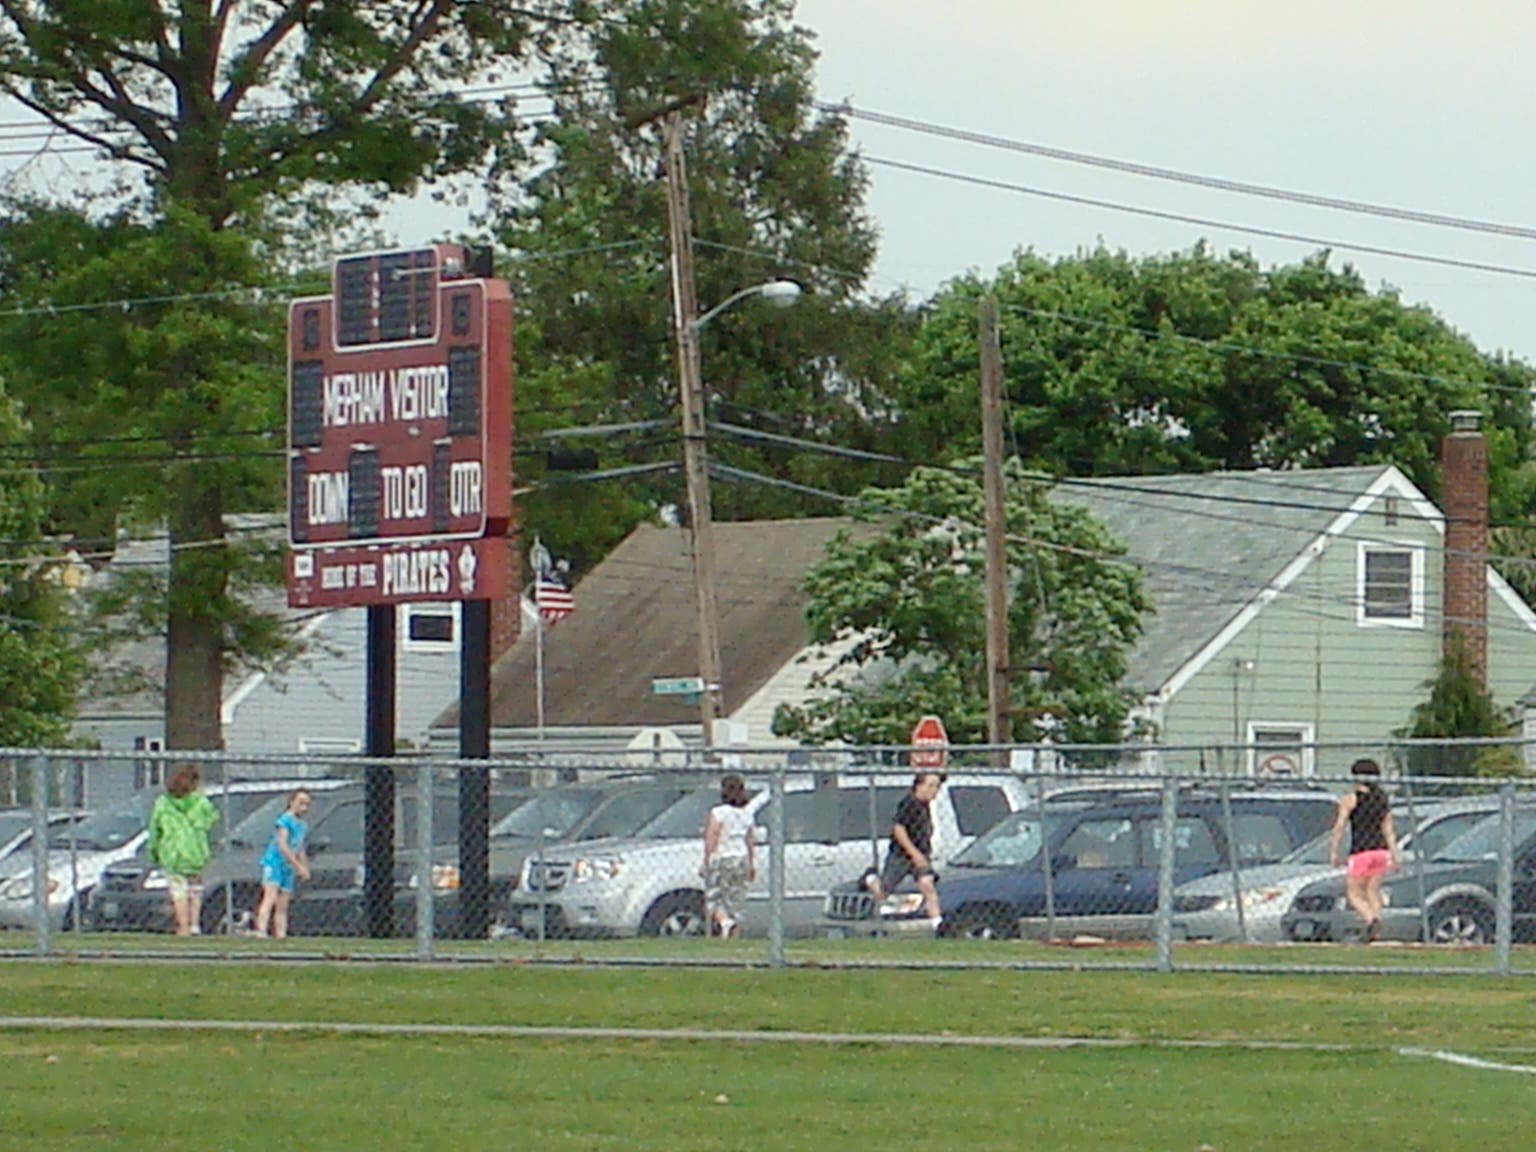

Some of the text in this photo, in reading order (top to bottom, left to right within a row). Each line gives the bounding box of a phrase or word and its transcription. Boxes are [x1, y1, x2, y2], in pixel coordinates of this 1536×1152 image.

[389, 365, 448, 420] VISITOR
[381, 464, 427, 518] TO GO
[382, 550, 449, 595] PIRATES
